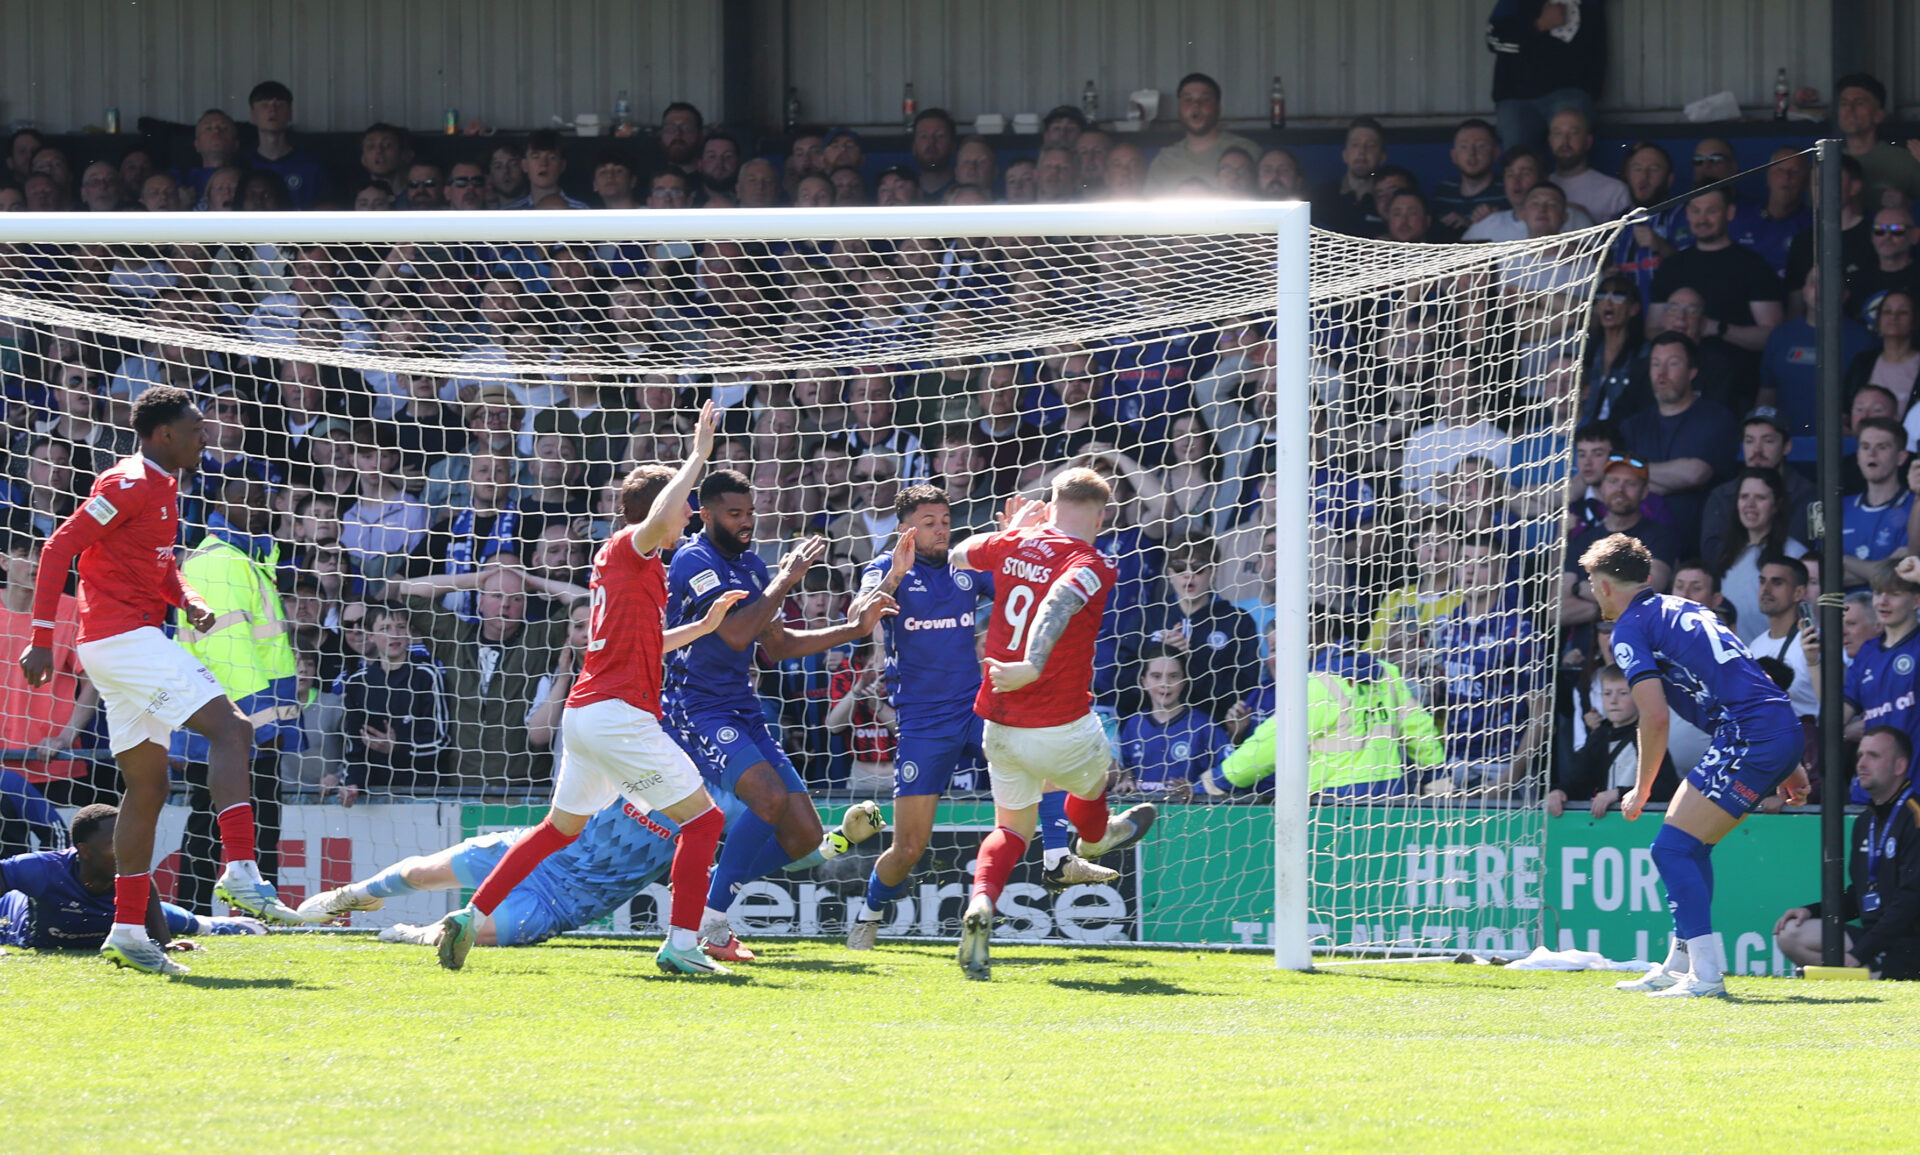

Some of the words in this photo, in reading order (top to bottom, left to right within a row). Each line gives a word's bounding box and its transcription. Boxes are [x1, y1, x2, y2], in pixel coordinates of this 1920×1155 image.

[1002, 556, 1053, 584] STONES
[904, 616, 957, 631] Crown
[960, 611, 975, 627] Oi
[1004, 584, 1035, 651] 9
[856, 727, 889, 738] own
[622, 802, 672, 841] Crown
[1406, 844, 1540, 910] HERE
[1561, 846, 1663, 912] FOR
